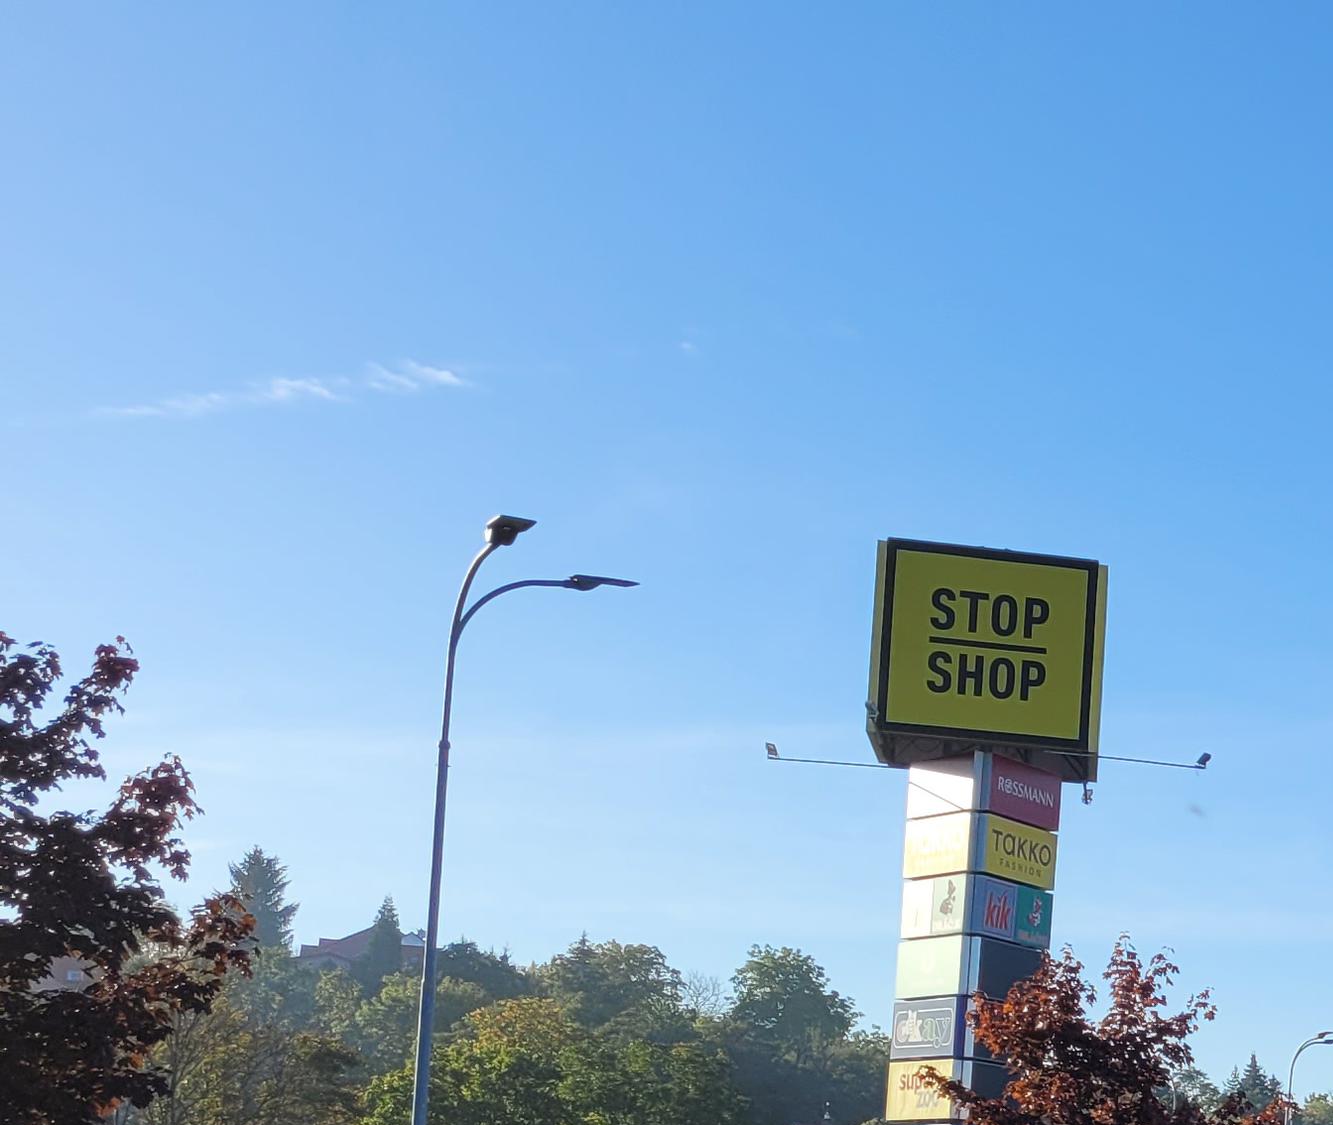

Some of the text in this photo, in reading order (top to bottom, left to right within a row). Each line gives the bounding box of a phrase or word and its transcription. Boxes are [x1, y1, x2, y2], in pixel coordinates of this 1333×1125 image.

[930, 587, 1050, 639] STOP
[926, 650, 1047, 701] SHOP
[997, 776, 1054, 808] ROSSMANN
[1000, 858, 1042, 878] FASHION
